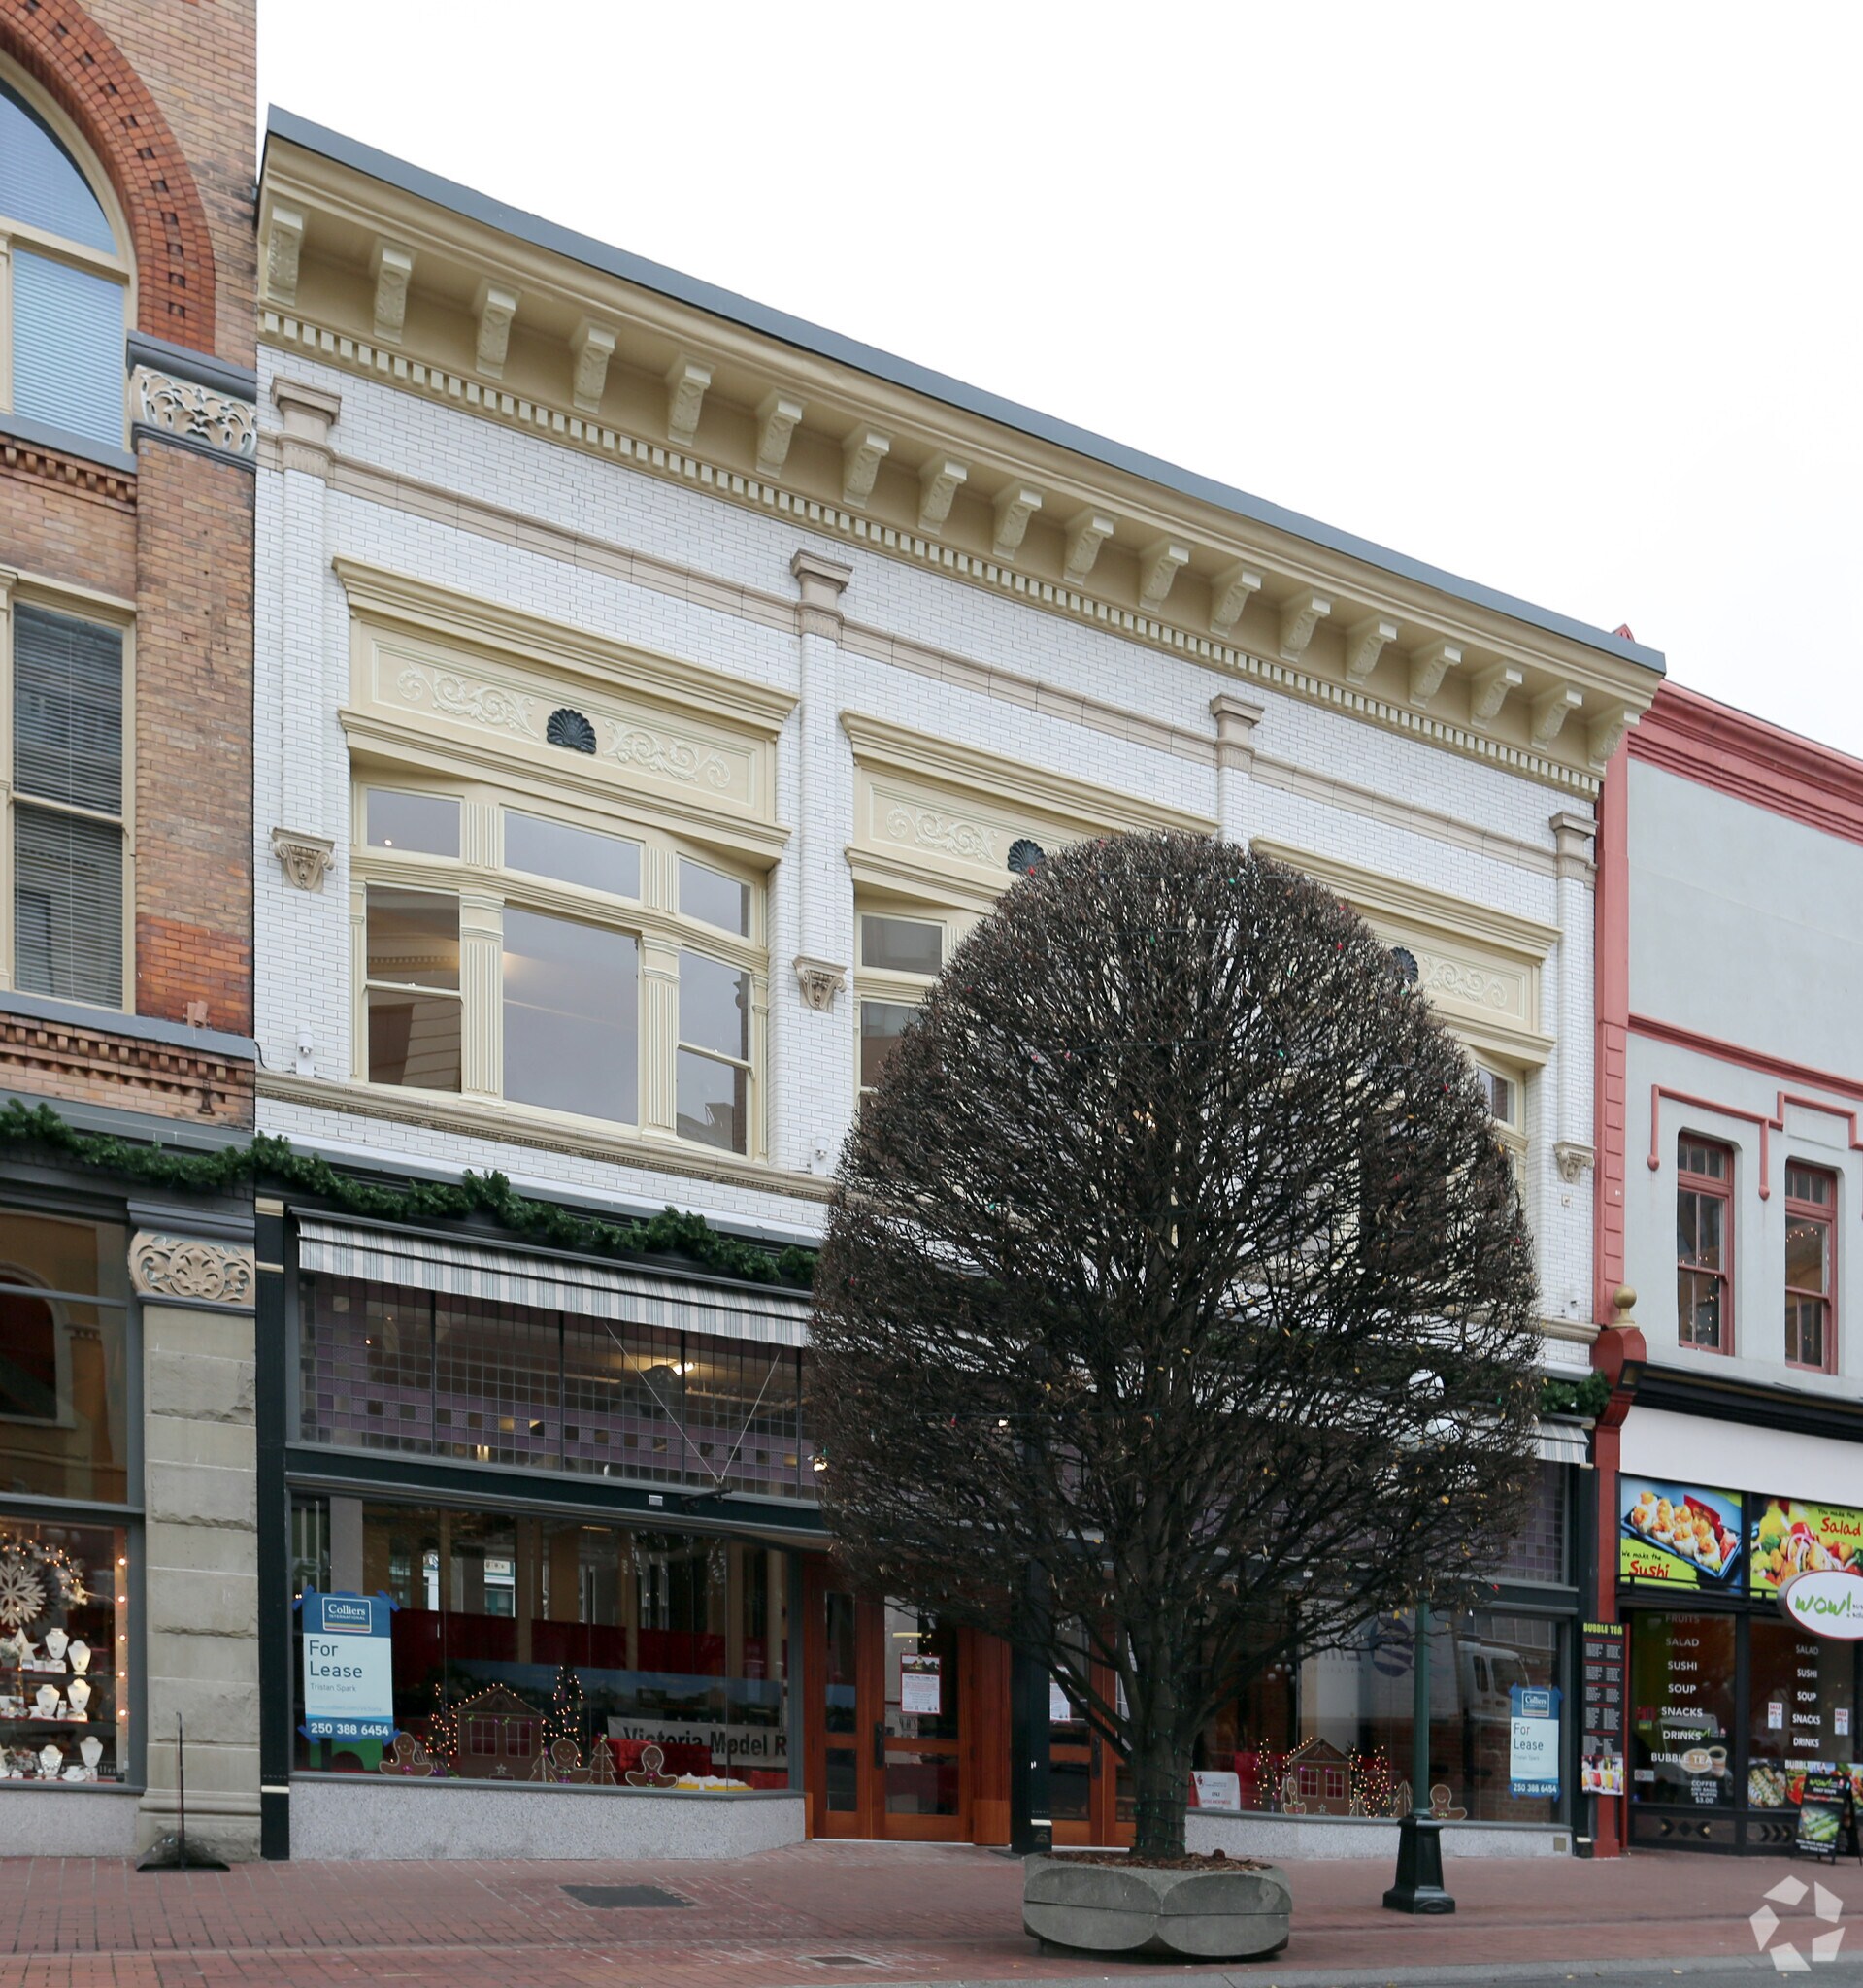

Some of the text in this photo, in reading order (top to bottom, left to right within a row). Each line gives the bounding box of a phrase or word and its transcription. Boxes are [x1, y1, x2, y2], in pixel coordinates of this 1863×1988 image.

[1820, 1516, 1861, 1536] Salad
[1628, 1559, 1670, 1578] Sushi
[328, 1603, 366, 1616] Colliers
[1665, 1614, 1700, 1624] FRUITS
[1583, 1622, 1623, 1635] BUBBLE TEA
[309, 1640, 338, 1657] For
[1665, 1638, 1700, 1647] SALAD
[1795, 1644, 1819, 1655] SALAD
[310, 1660, 363, 1678] Lease
[1667, 1661, 1698, 1671] SUSHI
[1797, 1668, 1817, 1678] SUSHI
[311, 1682, 356, 1693] Tristan Spark
[1668, 1683, 1697, 1694] SOUP
[1524, 1695, 1547, 1706] Colliers
[1797, 1691, 1817, 1702] SOUP
[1661, 1706, 1703, 1718] SNACKS
[1792, 1713, 1820, 1725] SNACKS
[311, 1722, 389, 1737] 250 388 6454
[1514, 1722, 1530, 1736] For
[1663, 1730, 1701, 1740] DRINKS
[710, 1731, 768, 1756] Model
[1514, 1739, 1544, 1751] Lease
[1793, 1737, 1820, 1748] DRINKS
[1650, 1752, 1713, 1766] BUBBLE TEA
[1513, 1782, 1525, 1792] 250
[1540, 1784, 1557, 1794] 6454
[1691, 1779, 1717, 1788] COFFEE
[1695, 1796, 1713, 1805] $3.00
